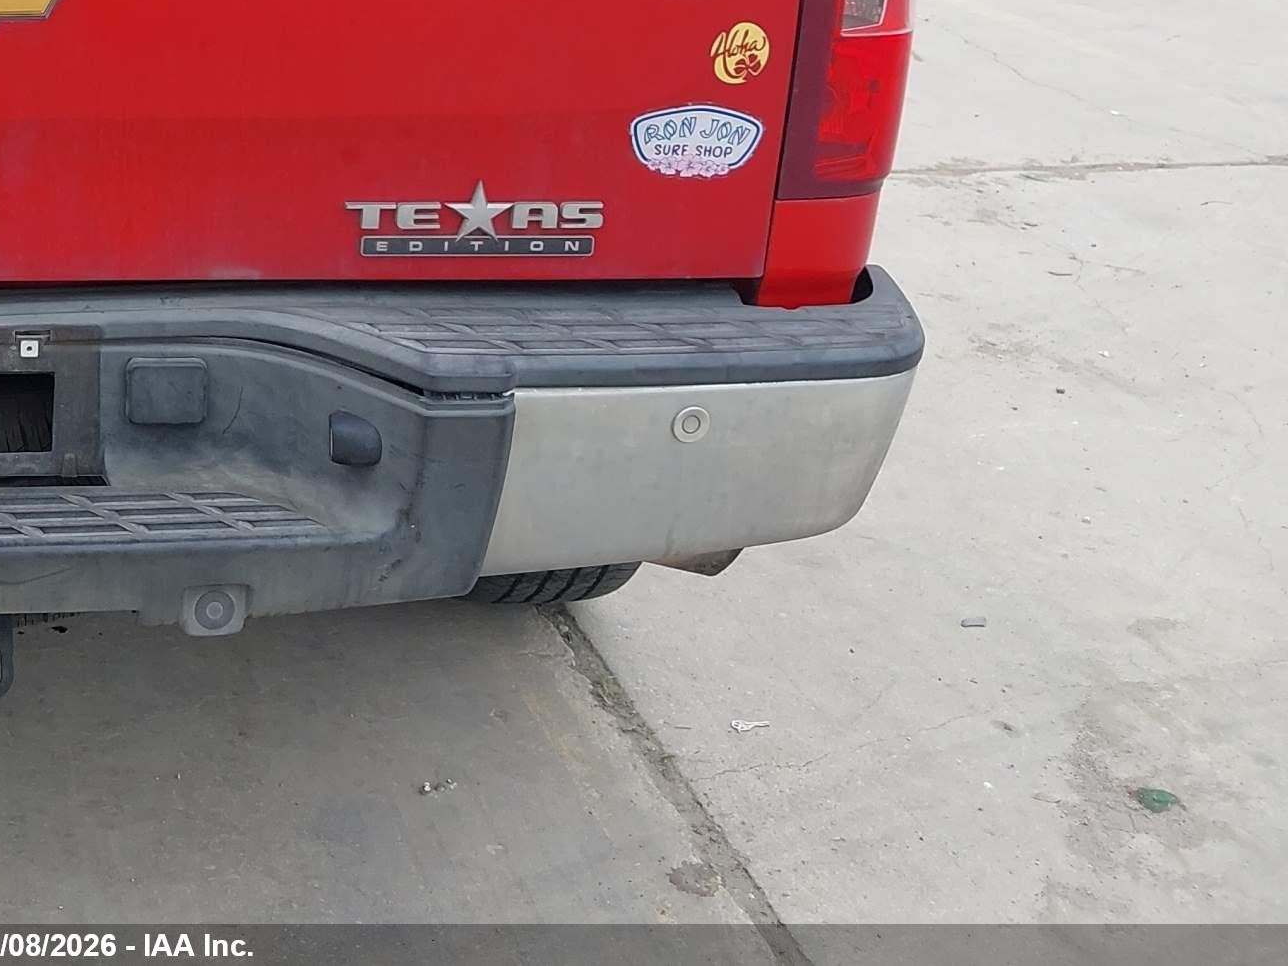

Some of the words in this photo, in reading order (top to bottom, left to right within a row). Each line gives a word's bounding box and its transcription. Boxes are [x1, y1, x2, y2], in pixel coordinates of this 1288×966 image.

[713, 29, 766, 76] Aloha
[644, 116, 697, 145] RON
[700, 118, 751, 146] JON
[654, 144, 689, 157] SURF
[695, 144, 733, 158] SHOP
[375, 240, 580, 252] EDITION
